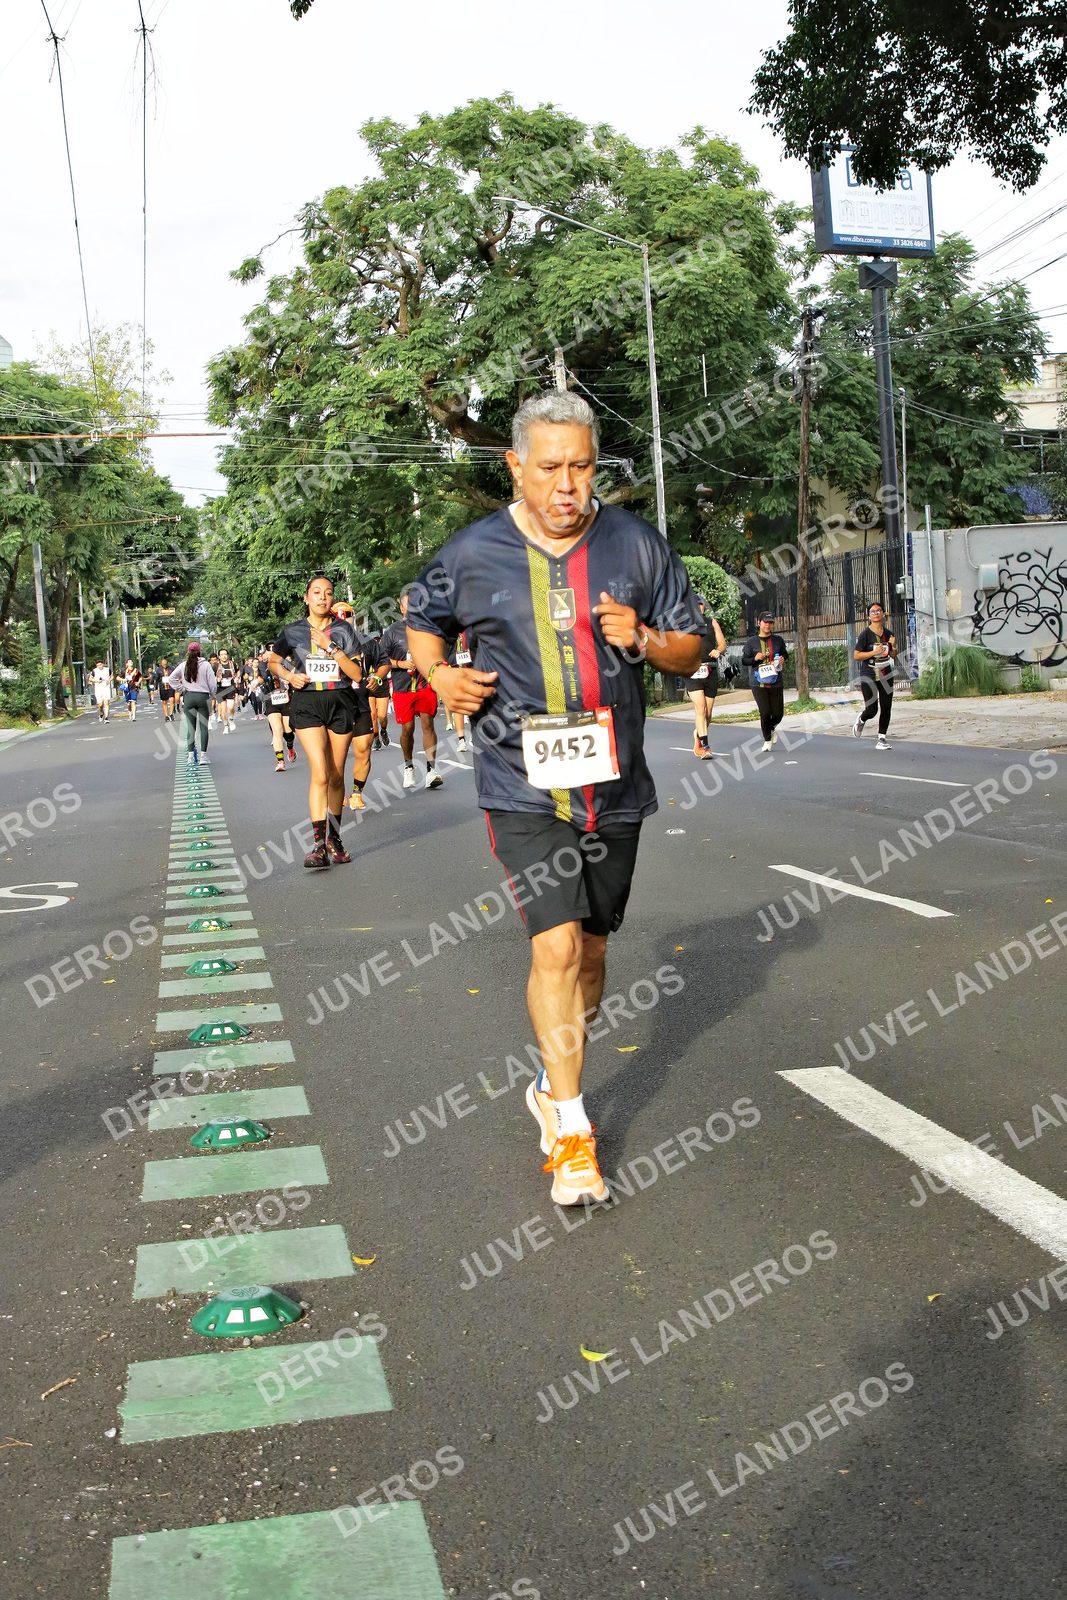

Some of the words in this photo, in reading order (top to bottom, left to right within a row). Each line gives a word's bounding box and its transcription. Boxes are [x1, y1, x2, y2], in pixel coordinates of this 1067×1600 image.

[998, 547, 1053, 568] TOY
[308, 663, 337, 673] 12857
[534, 734, 597, 764] 9452
